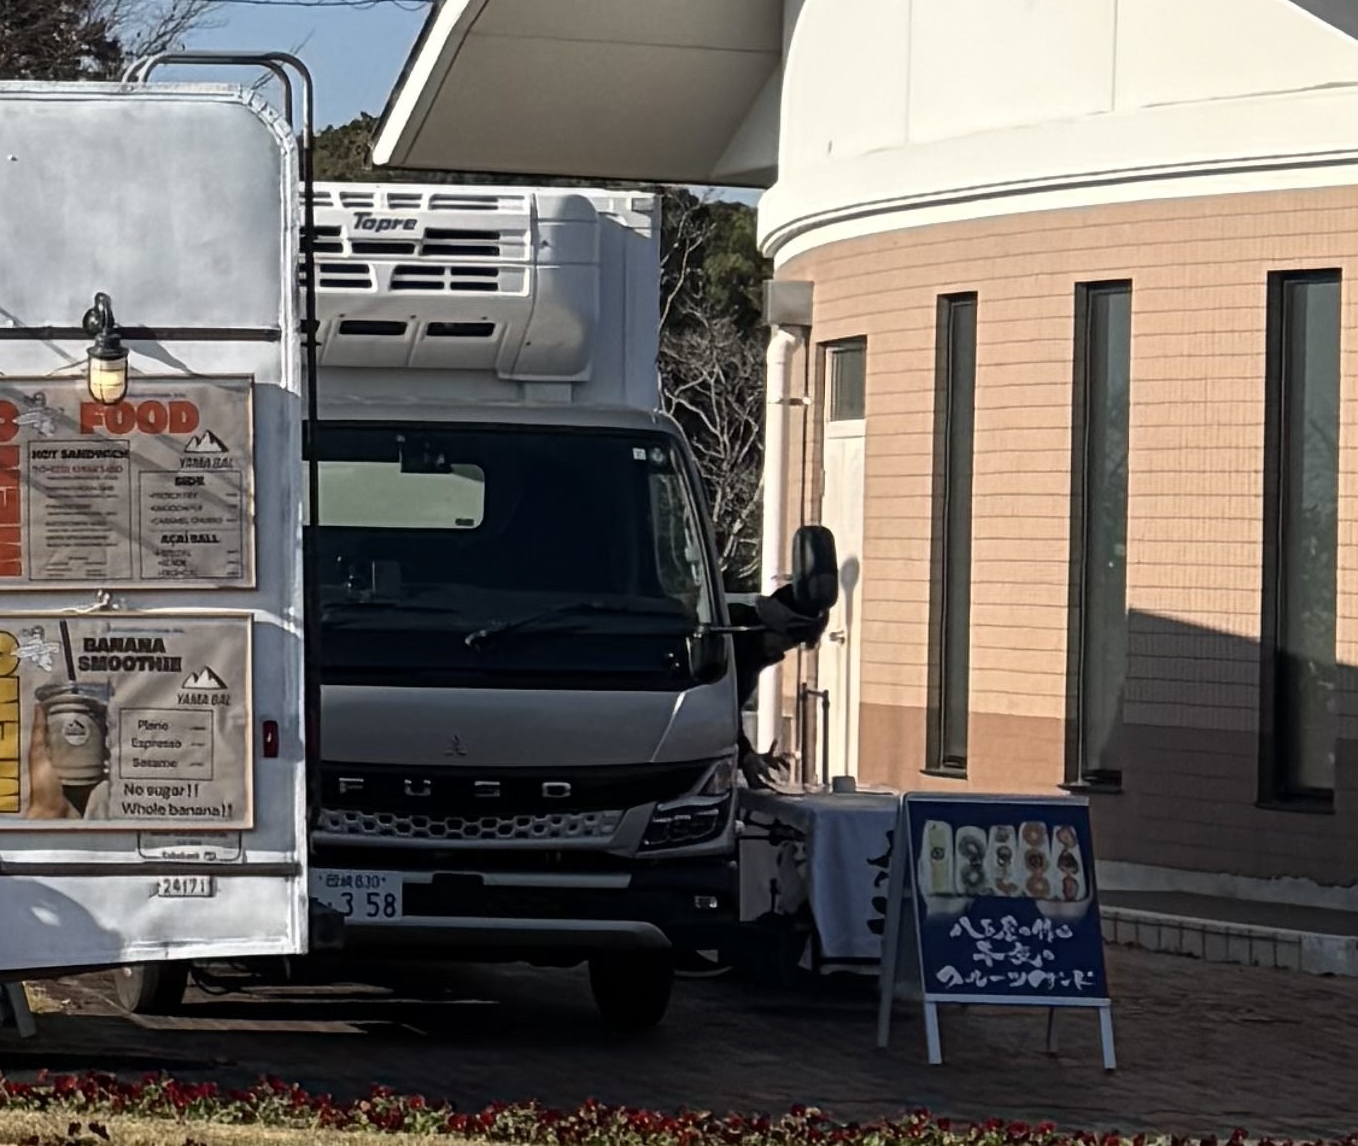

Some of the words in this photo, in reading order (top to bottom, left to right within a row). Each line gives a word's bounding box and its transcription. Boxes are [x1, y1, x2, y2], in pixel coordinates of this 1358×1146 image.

[353, 211, 418, 233] Topre
[80, 401, 199, 434] FOOD
[31, 449, 58, 460] HOT
[60, 449, 129, 460] SANDWICH
[83, 637, 166, 654] BANANA
[78, 655, 182, 673] SMOOTHIE
[123, 783, 144, 797] No
[339, 777, 571, 798] FUSO
[121, 802, 166, 816] Whole
[163, 878, 205, 894] 24171
